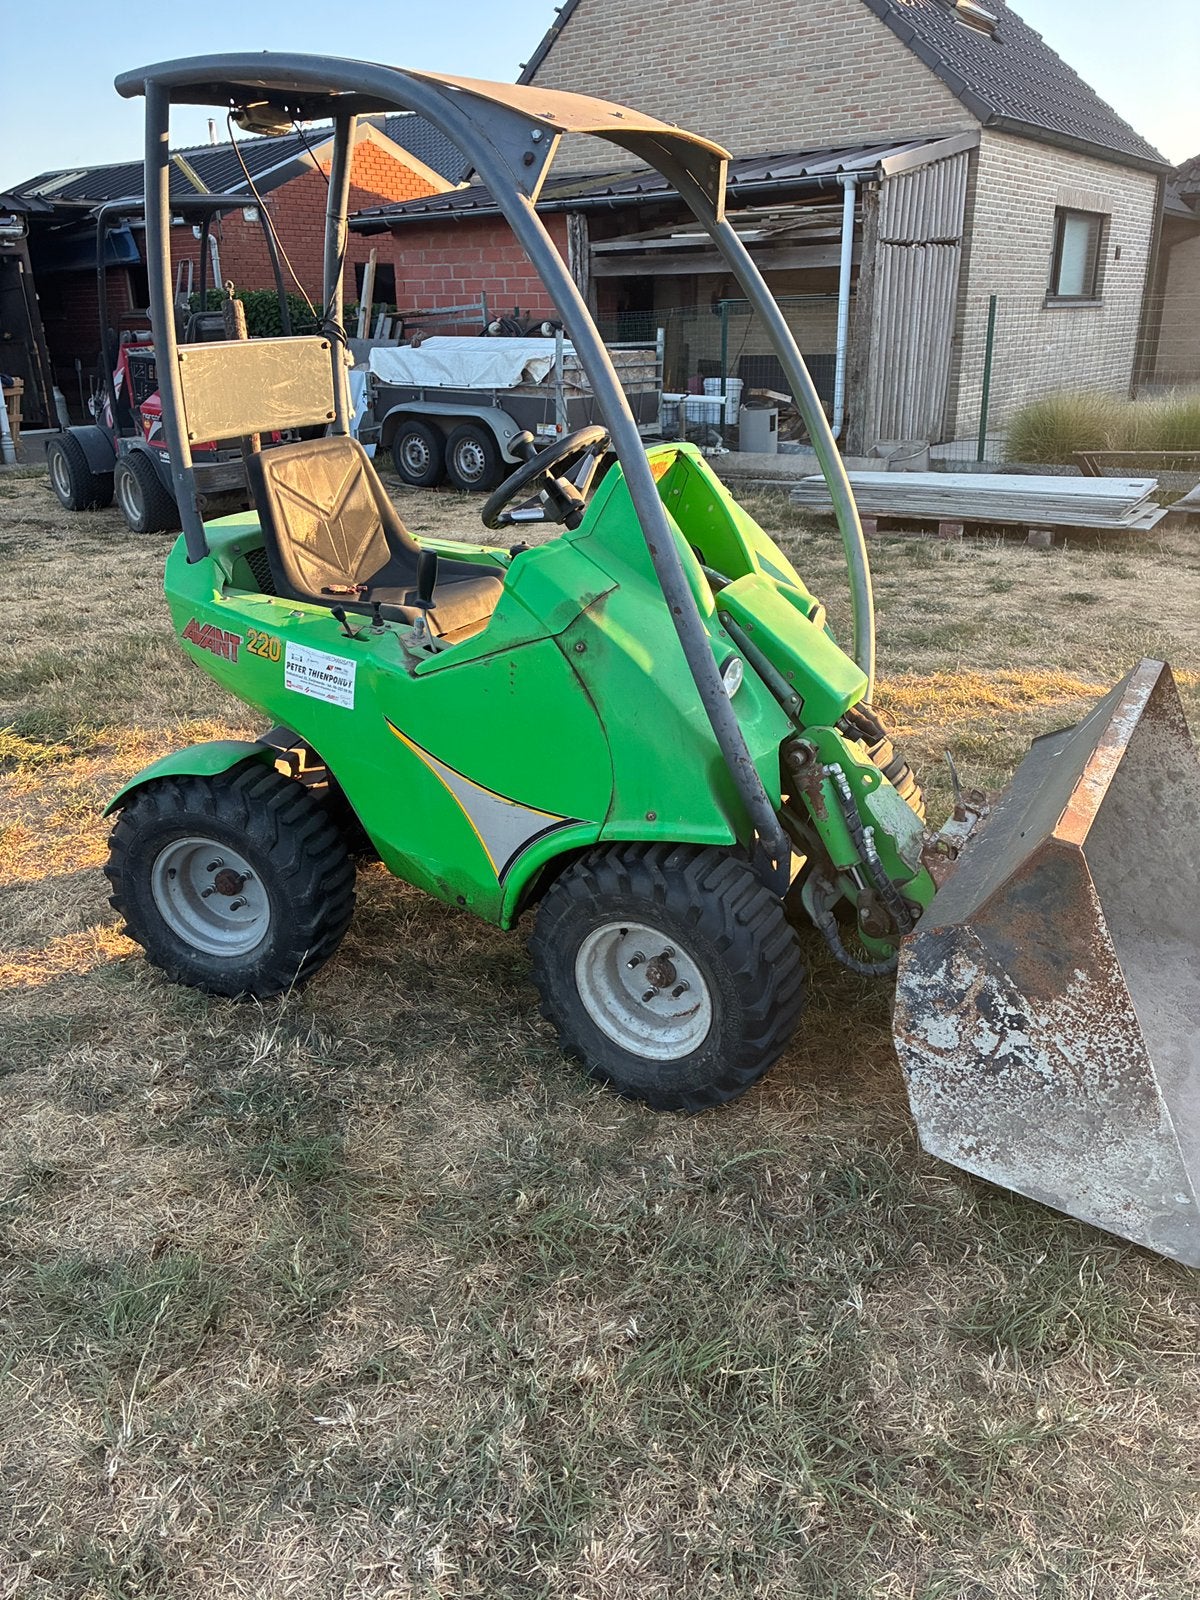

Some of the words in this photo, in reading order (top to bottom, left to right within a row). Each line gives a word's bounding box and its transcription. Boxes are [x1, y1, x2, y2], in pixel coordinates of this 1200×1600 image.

[181, 617, 243, 664] AVANT
[246, 627, 281, 663] 220
[286, 661, 307, 676] PETER
